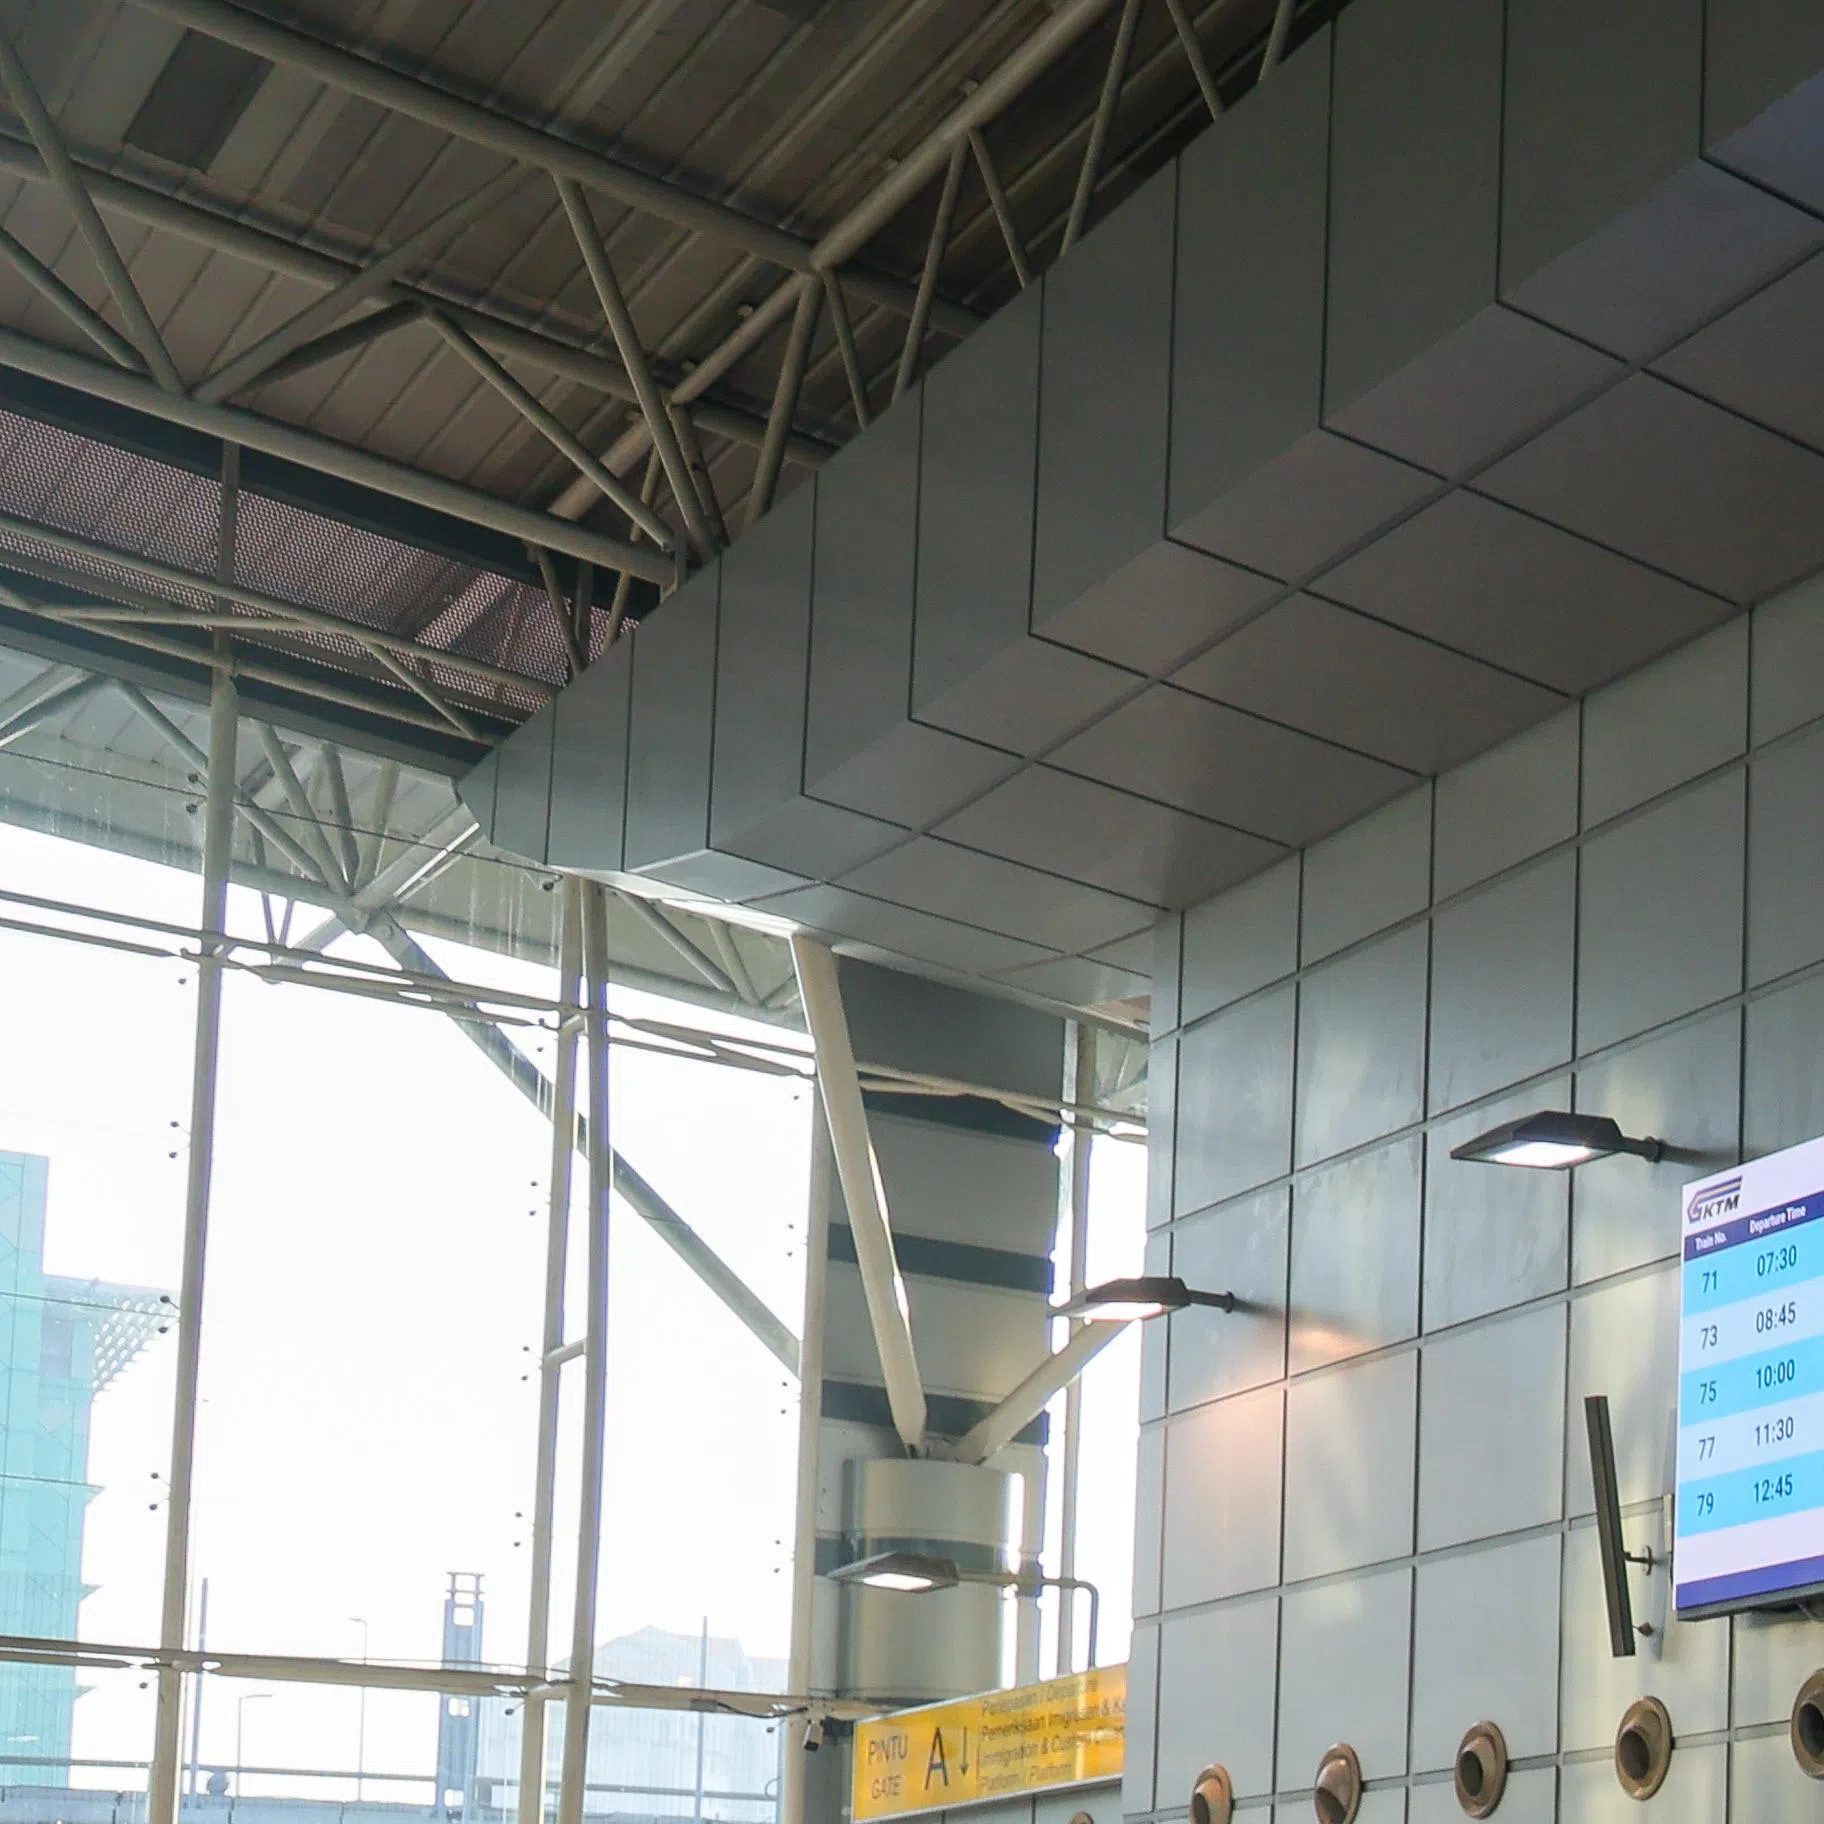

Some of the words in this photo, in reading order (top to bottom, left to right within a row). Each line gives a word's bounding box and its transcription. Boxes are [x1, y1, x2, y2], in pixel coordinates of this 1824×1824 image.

[1699, 1192, 1741, 1220] KTM
[1756, 1244, 1798, 1280] 07:30
[1701, 1270, 1719, 1294] 71
[1755, 1301, 1797, 1334] 08:45
[1700, 1325, 1719, 1350] 73
[1755, 1359, 1796, 1391] 10:00
[1699, 1381, 1718, 1404] 75
[1754, 1416, 1795, 1448] 11:30
[1698, 1436, 1716, 1460] 77
[1753, 1472, 1794, 1504] 12:45
[1697, 1492, 1715, 1516] 79
[868, 1735, 908, 1766] PINTU
[924, 1726, 949, 1791] A
[871, 1774, 901, 1800] GATE
